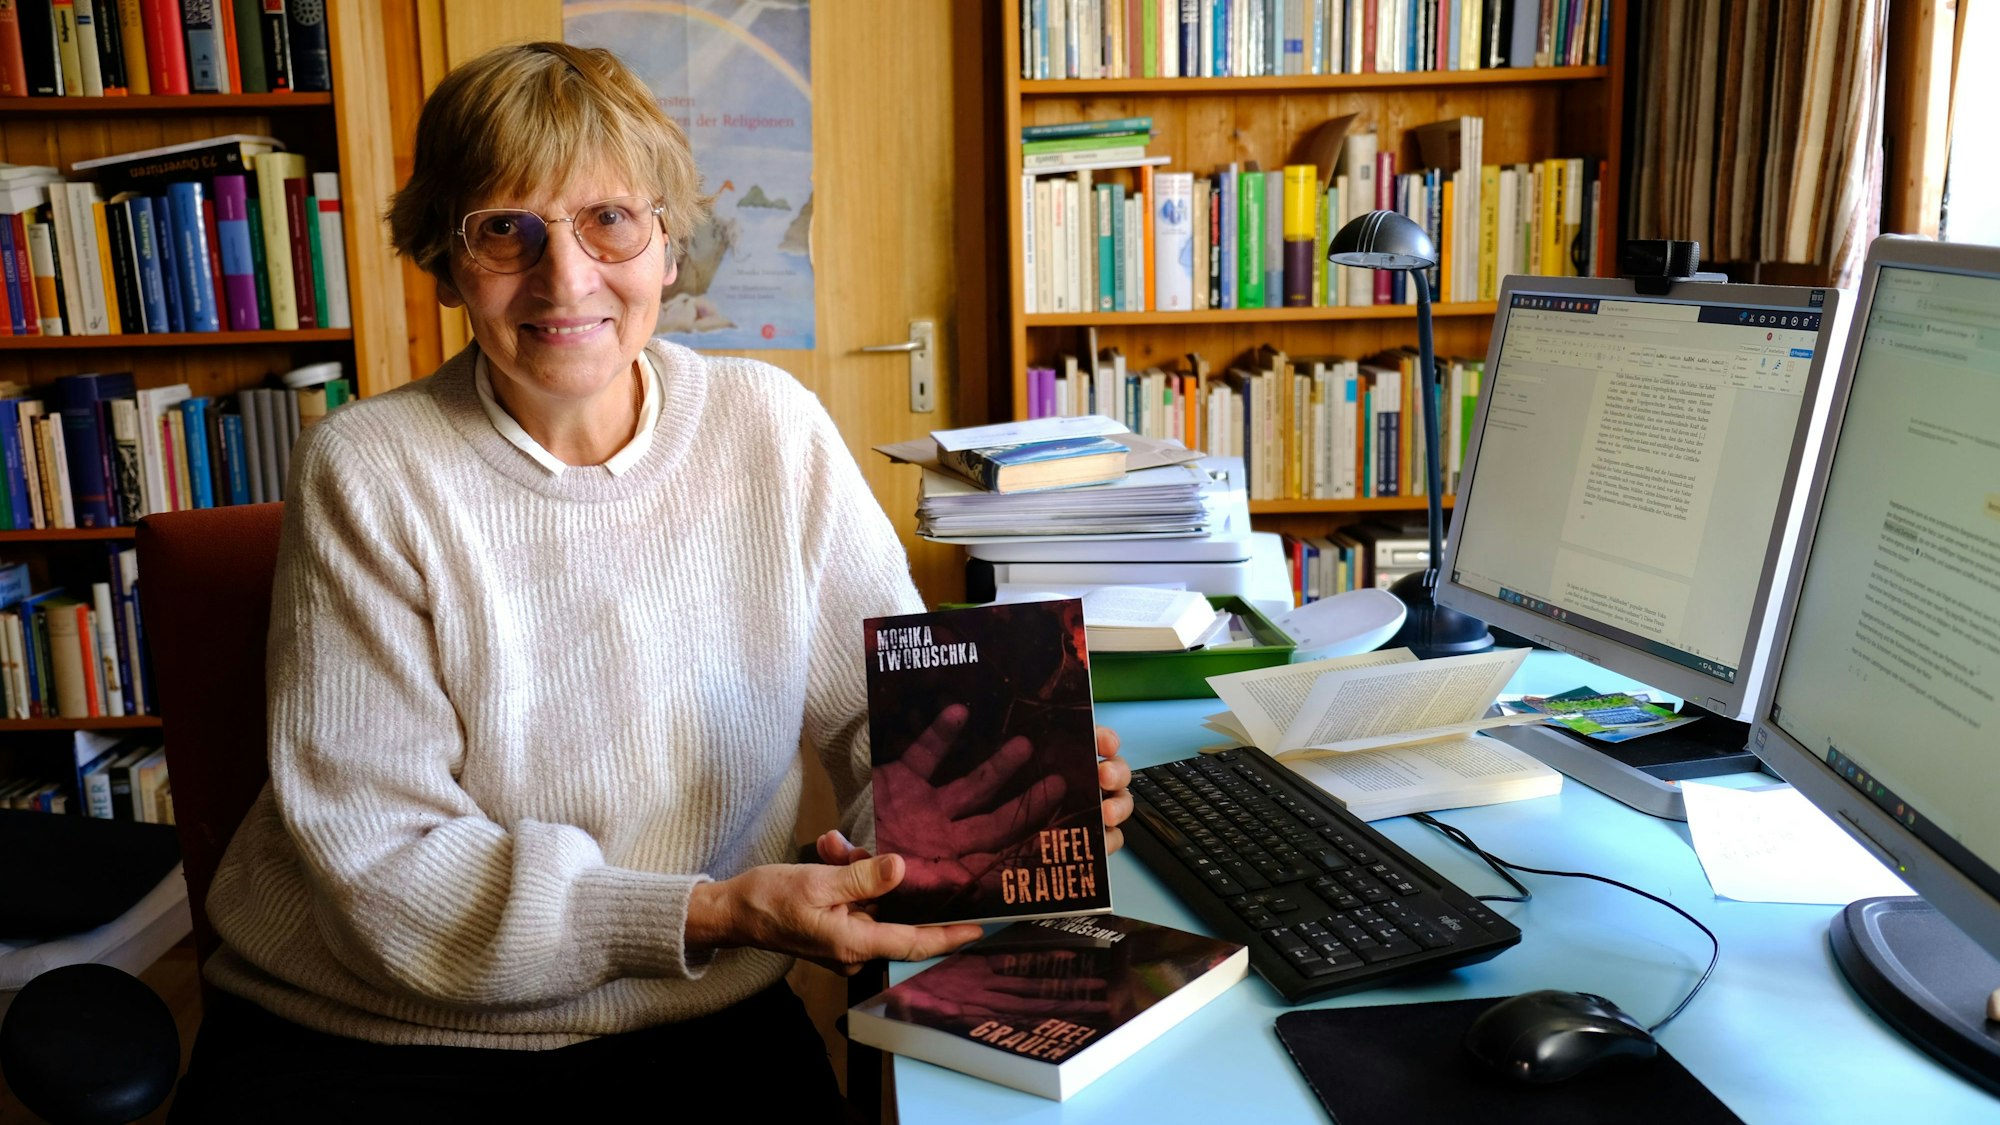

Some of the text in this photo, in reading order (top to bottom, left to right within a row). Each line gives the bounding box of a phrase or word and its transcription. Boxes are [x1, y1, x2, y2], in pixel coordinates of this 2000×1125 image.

[696, 114, 717, 127] der
[723, 114, 794, 131] Religionen
[876, 626, 933, 652] MONIKA
[878, 643, 979, 673] TWORUSCHKA
[1040, 827, 1094, 864] EIFEL
[1002, 863, 1097, 905] GRAUEN
[969, 1020, 1076, 1061] GRAUEN
[1033, 1017, 1098, 1045] EIFEL
